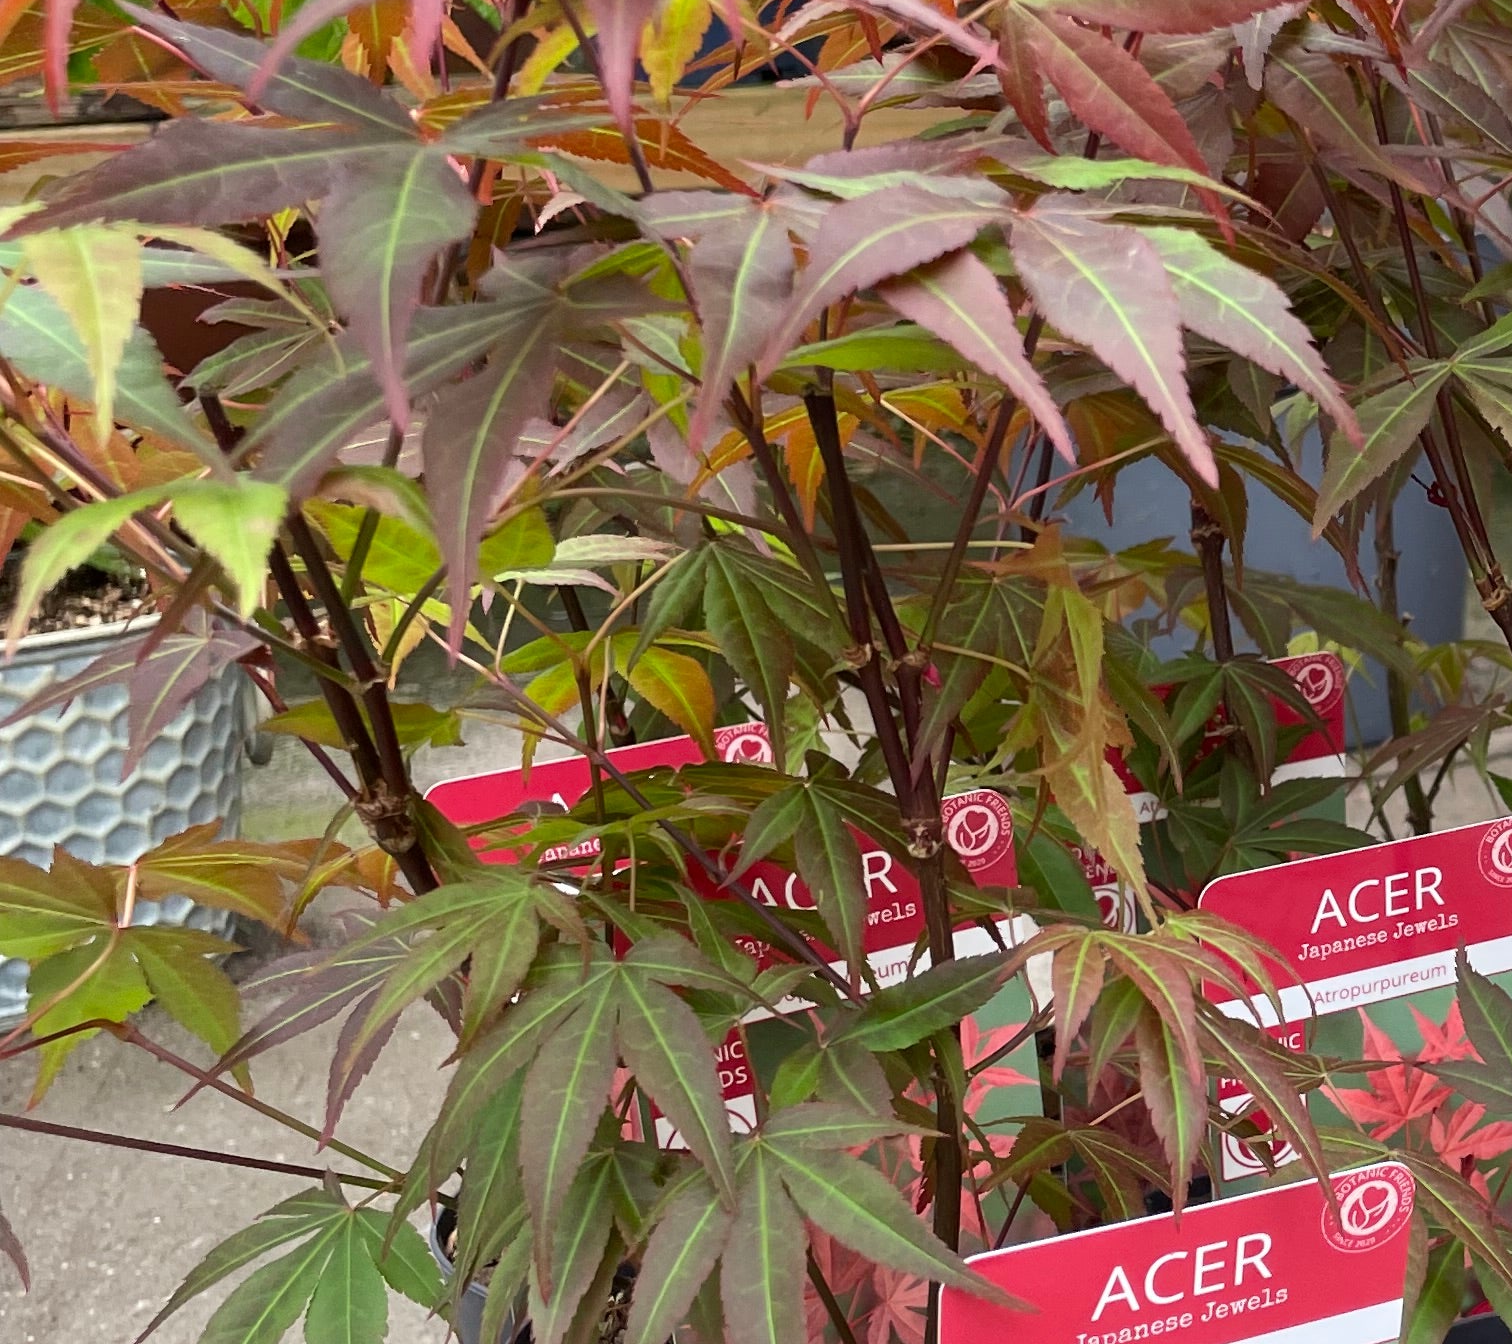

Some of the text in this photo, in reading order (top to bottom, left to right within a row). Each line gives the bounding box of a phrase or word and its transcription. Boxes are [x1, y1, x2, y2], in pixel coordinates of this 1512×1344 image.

[985, 795, 1011, 837] FRIENDS
[866, 902, 917, 926] wels
[1310, 866, 1445, 935] ACER
[1298, 913, 1460, 961] Japanese Jewels
[1313, 962, 1447, 1005] Atropurpureum
[1388, 1168, 1413, 1213] FRIENDS
[1091, 1232, 1273, 1322] ACER
[1200, 1286, 1289, 1323] Jewels
